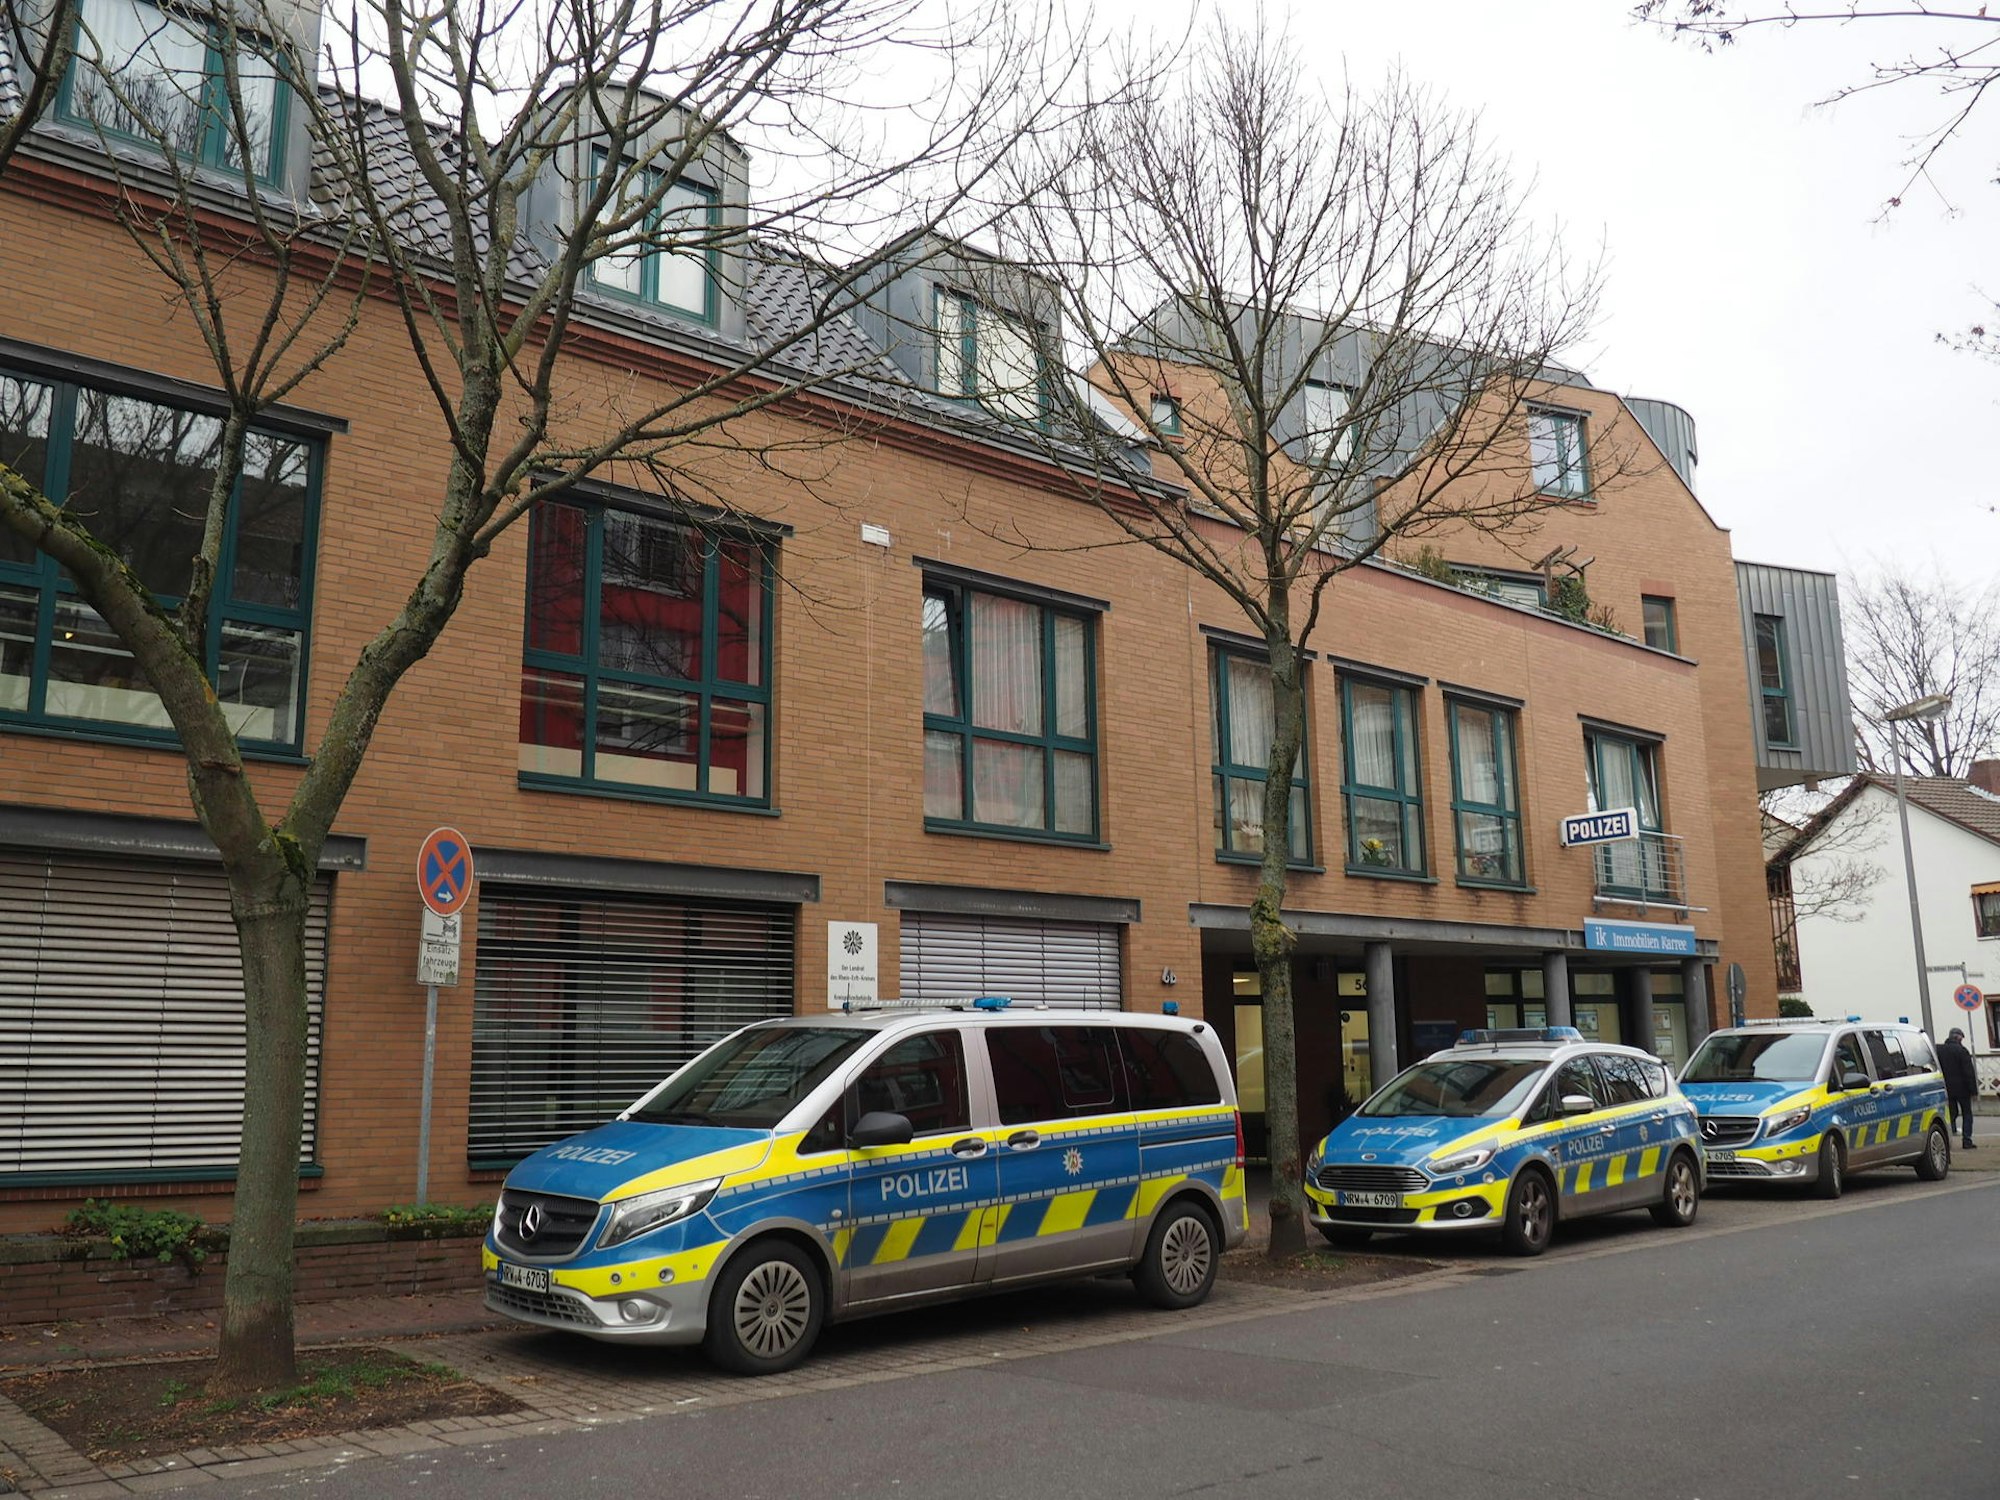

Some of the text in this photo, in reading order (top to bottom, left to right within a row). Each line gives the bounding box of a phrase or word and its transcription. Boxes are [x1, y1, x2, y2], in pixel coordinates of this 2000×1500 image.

[1569, 815, 1628, 841] POLIZEI
[426, 943, 455, 955] Einsatz-
[1612, 932, 1660, 949] Immobilien
[1661, 935, 1688, 951] Karree
[423, 955, 457, 969] fahrzeuge
[433, 969, 446, 979] frei
[1853, 1101, 1878, 1117] POLIZEI
[1350, 1126, 1439, 1137] POLIZEI
[1567, 1134, 1605, 1157] POLIZEI
[546, 1145, 638, 1165] POLIZEI
[880, 1166, 969, 1201] POLIZEI
